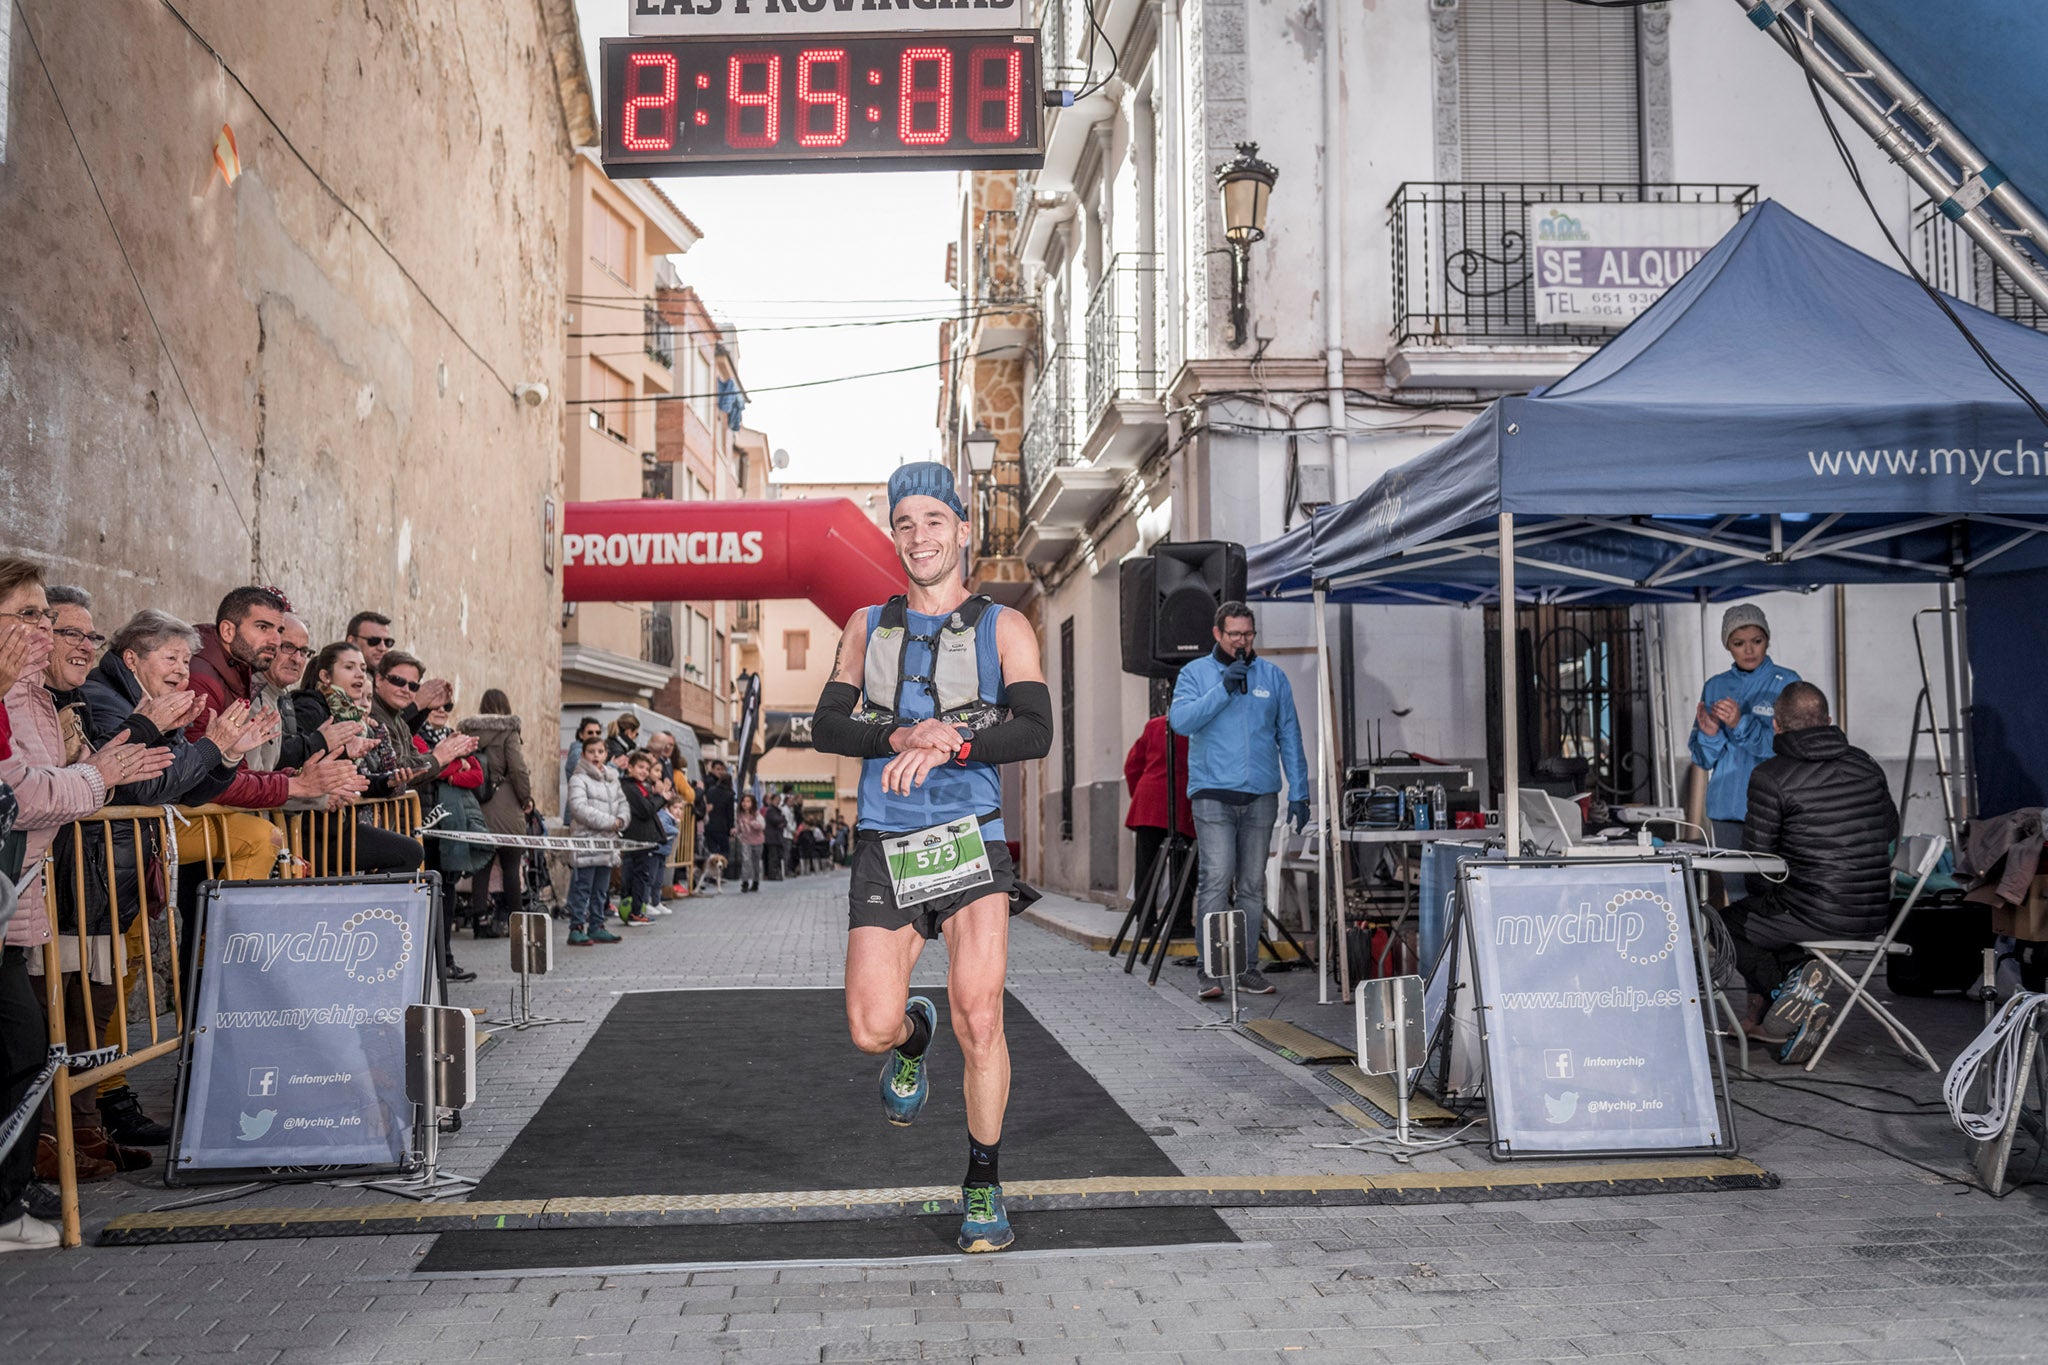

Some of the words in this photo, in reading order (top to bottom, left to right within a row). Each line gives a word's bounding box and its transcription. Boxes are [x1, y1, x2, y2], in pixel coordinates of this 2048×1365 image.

[621, 47, 1022, 151] 2:45:01
[1542, 249, 1583, 286] SE
[563, 531, 763, 566] PROVINCIAS
[916, 844, 957, 869] 573
[1496, 902, 1644, 955] mychip
[223, 922, 378, 972] mychip
[1500, 986, 1682, 1013] www.mychip.es
[216, 1003, 403, 1030] www.mychip.es
[1583, 1056, 1645, 1068] /infomychip
[288, 1072, 351, 1085] /infomychip
[1588, 1100, 1663, 1113] @Mychip_Info
[283, 1116, 361, 1130] @Mychip_Info
